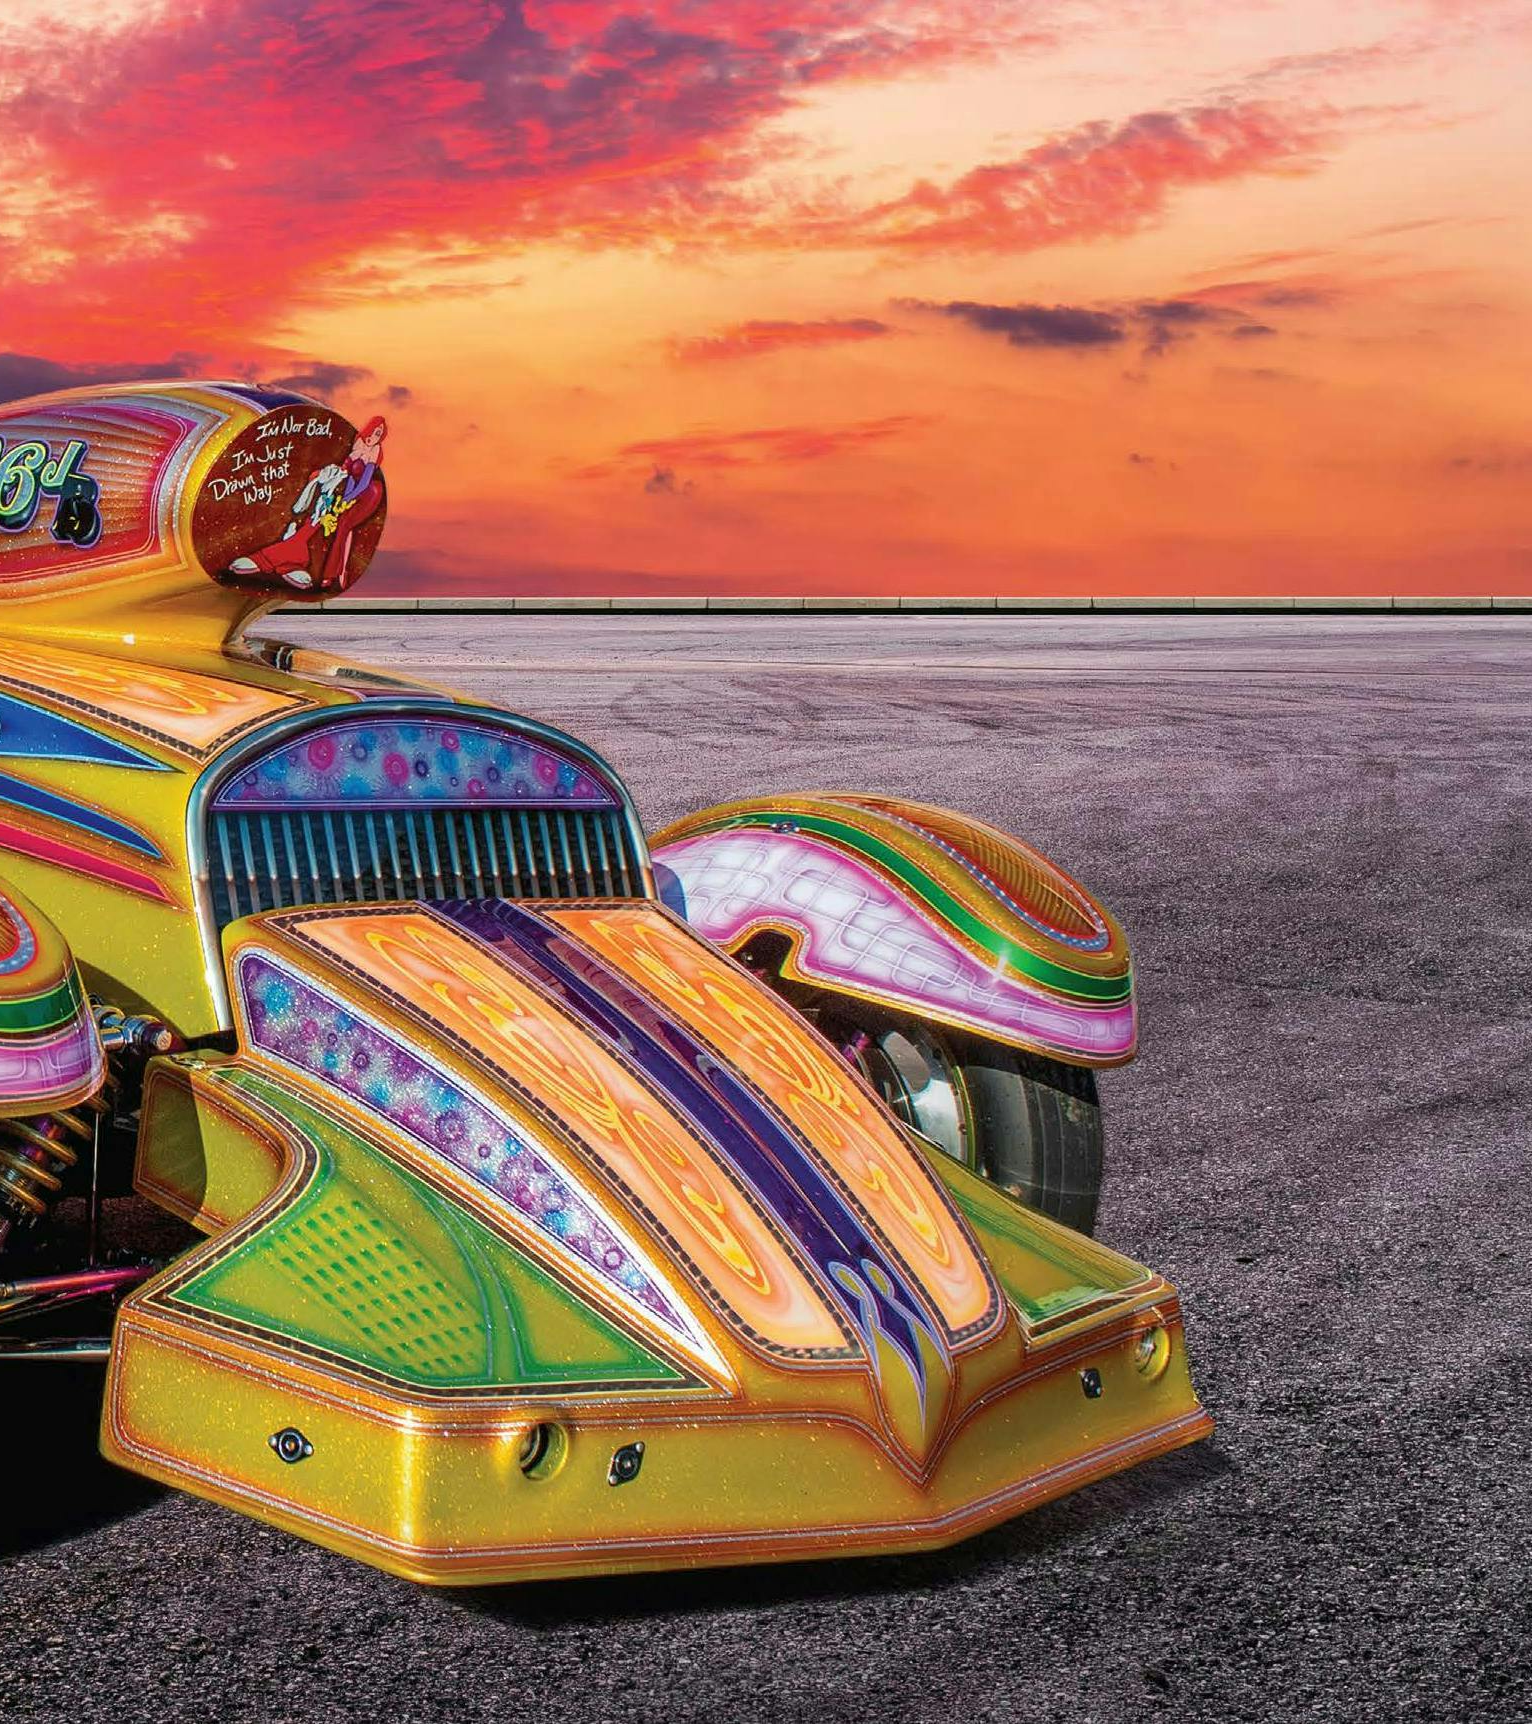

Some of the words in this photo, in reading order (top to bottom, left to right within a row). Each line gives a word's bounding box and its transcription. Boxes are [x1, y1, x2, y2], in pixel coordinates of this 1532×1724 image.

[255, 420, 279, 441] I'm
[231, 449, 255, 472] I'm
[256, 441, 295, 463] Just
[207, 473, 256, 501] Drawn
[260, 460, 291, 482] that
